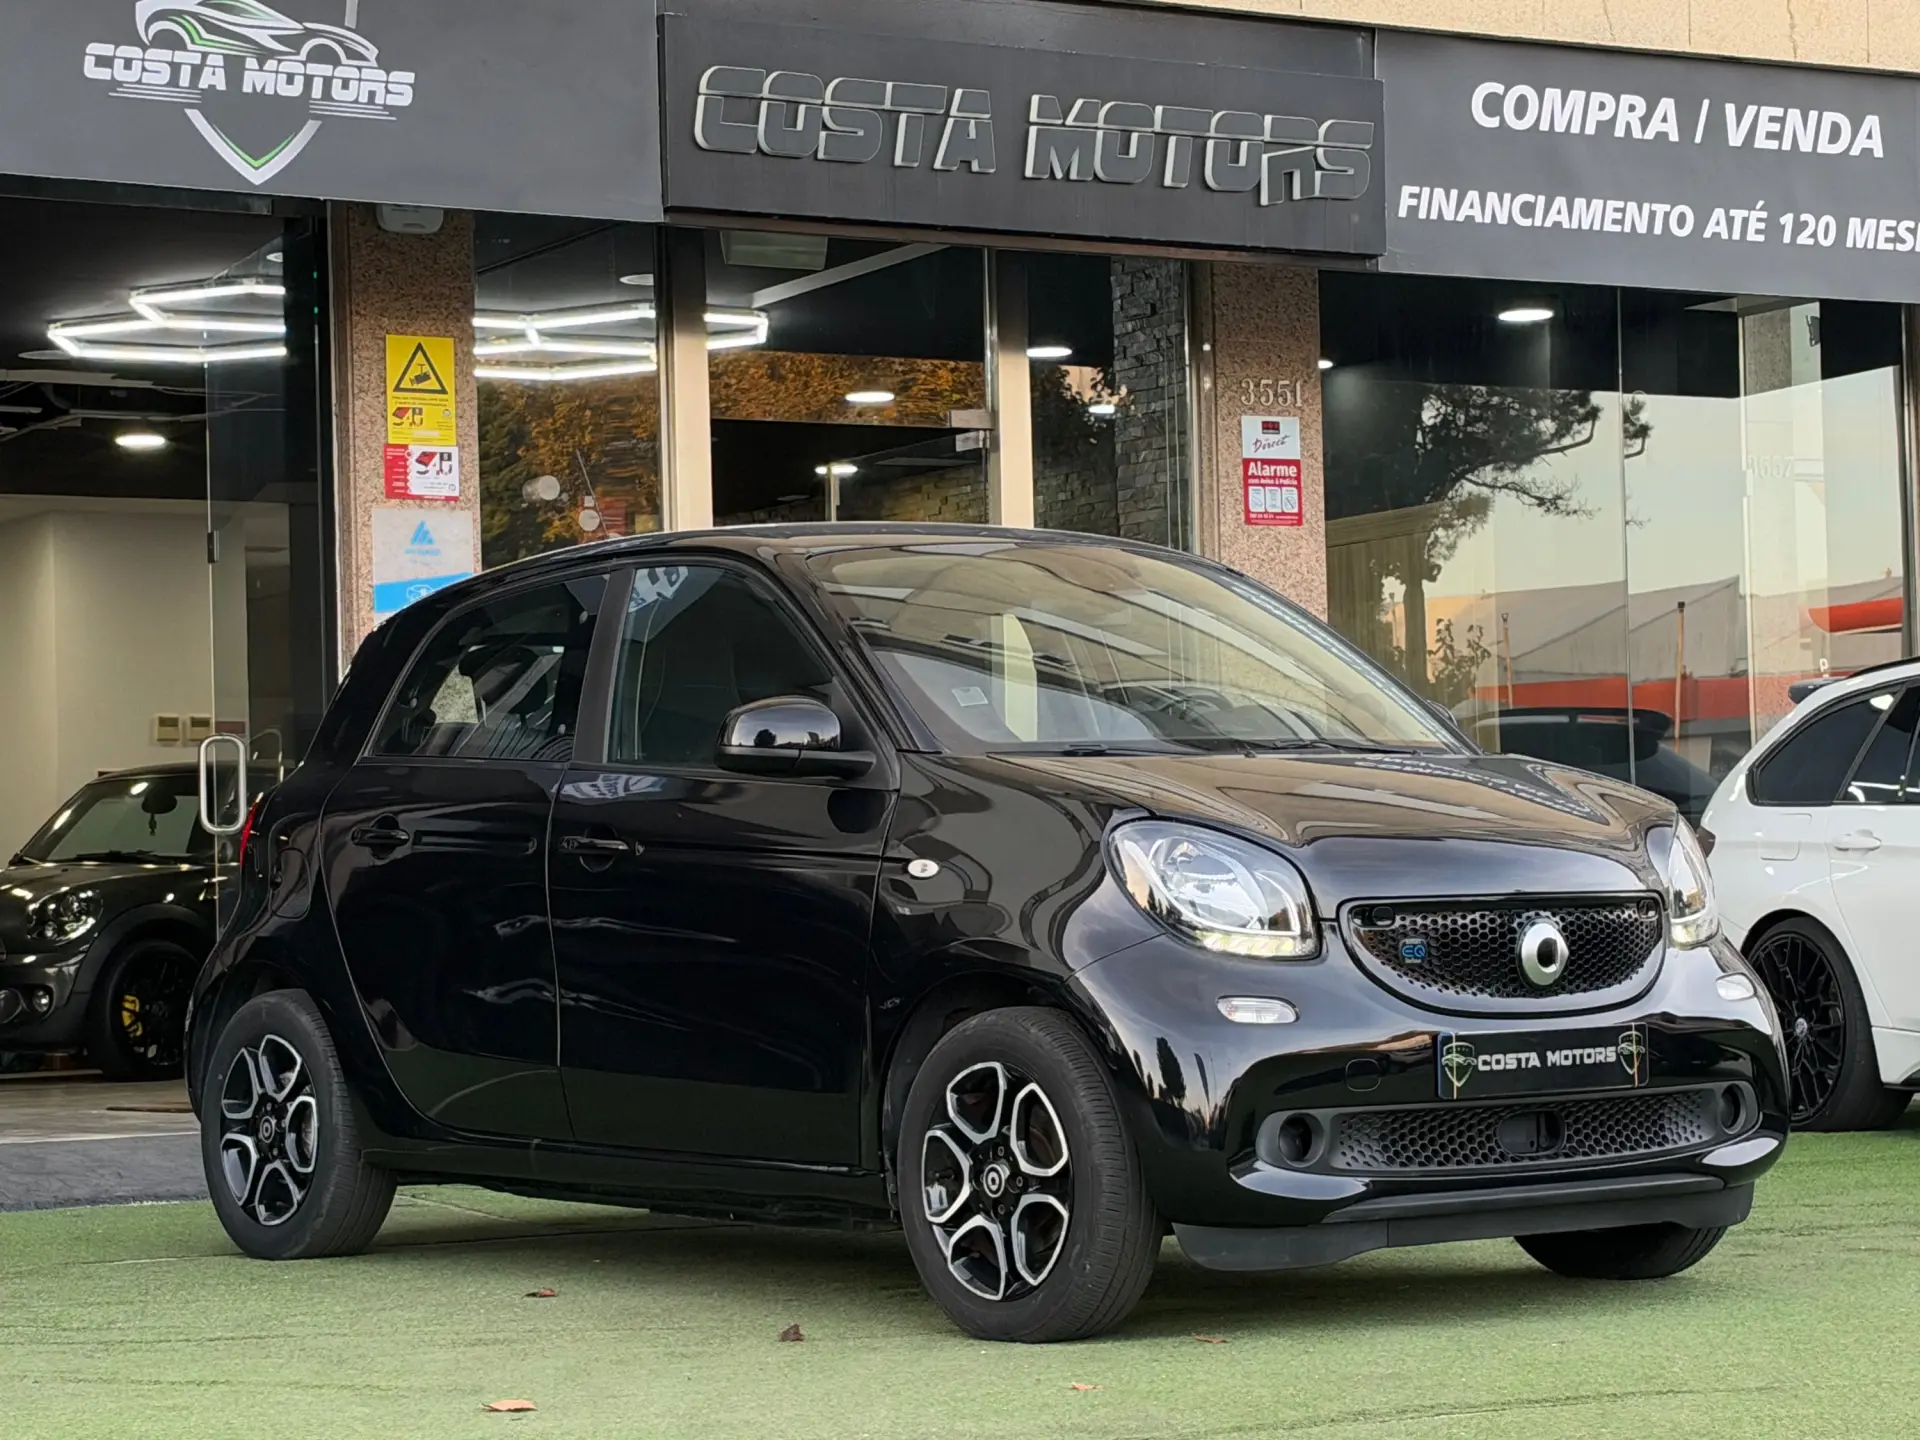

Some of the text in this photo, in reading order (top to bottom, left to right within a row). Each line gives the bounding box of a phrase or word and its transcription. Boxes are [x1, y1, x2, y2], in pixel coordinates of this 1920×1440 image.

[83, 43, 415, 107] COSTA MOTORS
[694, 65, 1375, 206] COSTA MOTORS
[1471, 81, 1885, 159] COMPRA / VENDA
[1398, 185, 1920, 253] FINANCIAMENTO ATÉ 120 MES
[1241, 378, 1303, 407] 3551
[1248, 461, 1297, 477] Alarme
[1401, 944, 1426, 958] EQ
[1477, 1046, 1617, 1072] COSTA MOTORS
